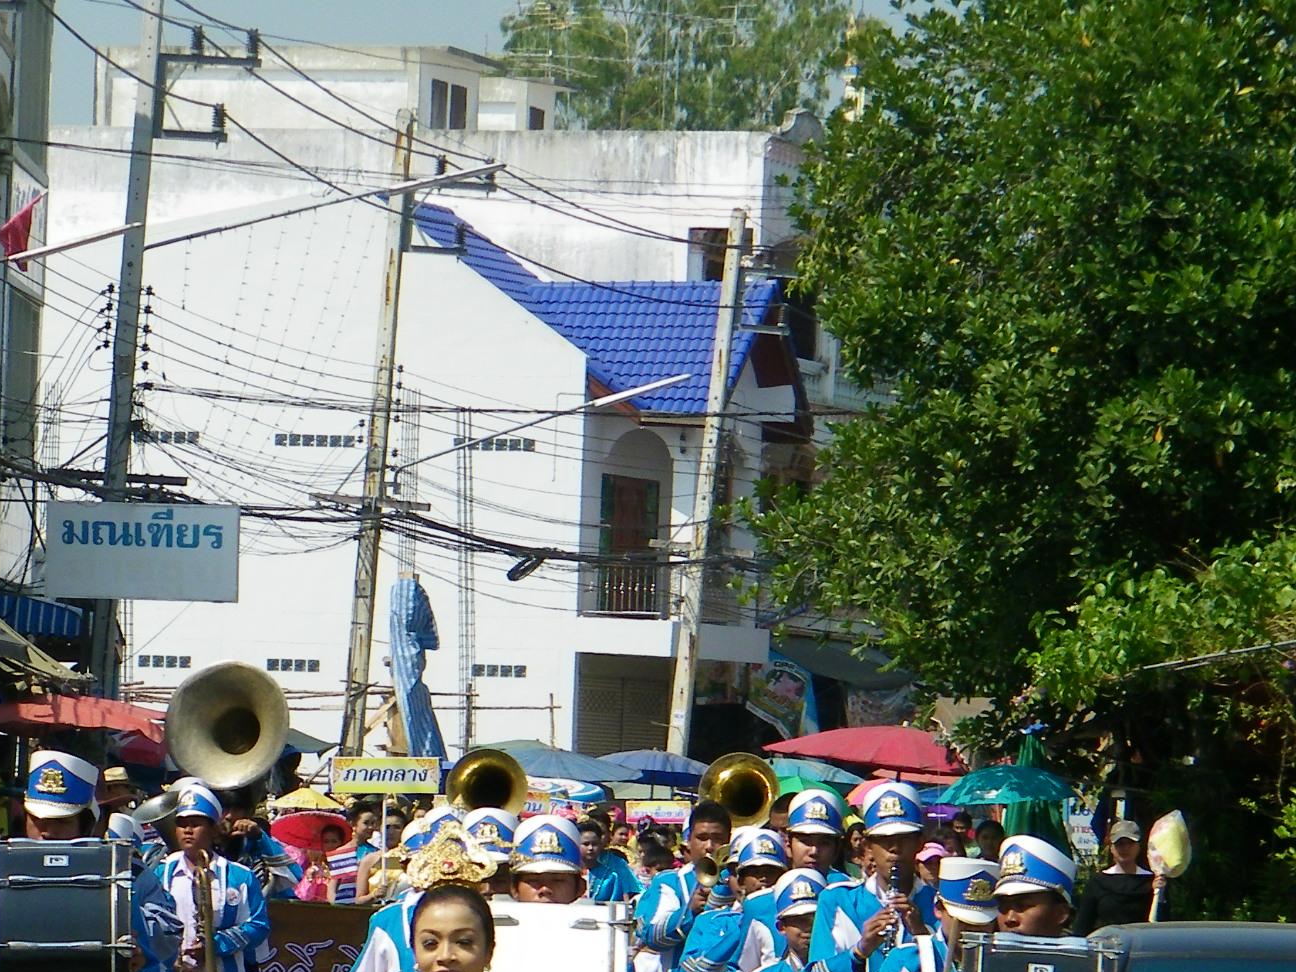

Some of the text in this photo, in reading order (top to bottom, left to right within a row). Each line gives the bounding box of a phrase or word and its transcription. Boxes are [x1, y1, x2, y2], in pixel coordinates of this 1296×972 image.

[61, 508, 223, 549] มณเฑียร
[343, 767, 429, 782] ภาคกลาง
